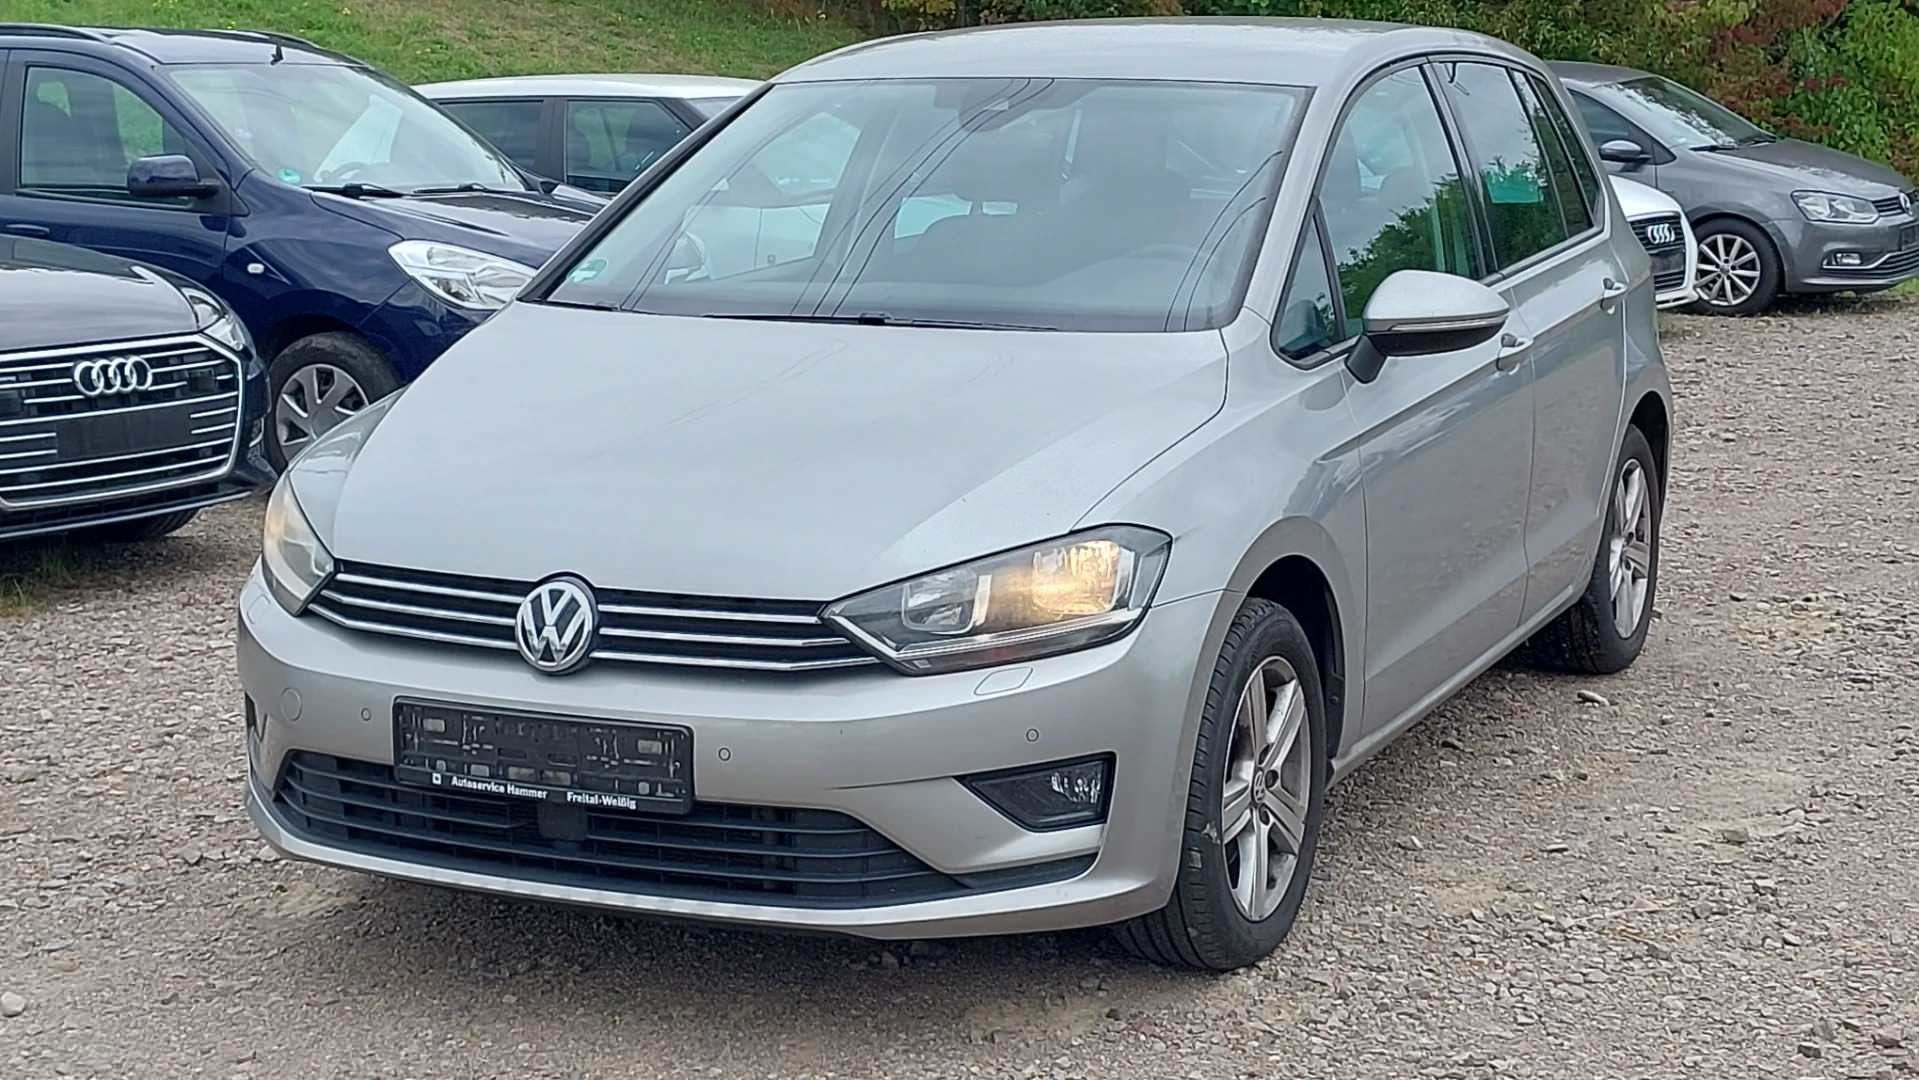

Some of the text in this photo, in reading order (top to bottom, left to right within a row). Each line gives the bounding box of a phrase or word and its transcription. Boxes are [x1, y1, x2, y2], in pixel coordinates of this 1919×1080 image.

[517, 582, 593, 668] VW
[451, 776, 505, 793] Autoservice
[507, 783, 548, 799] Hammer
